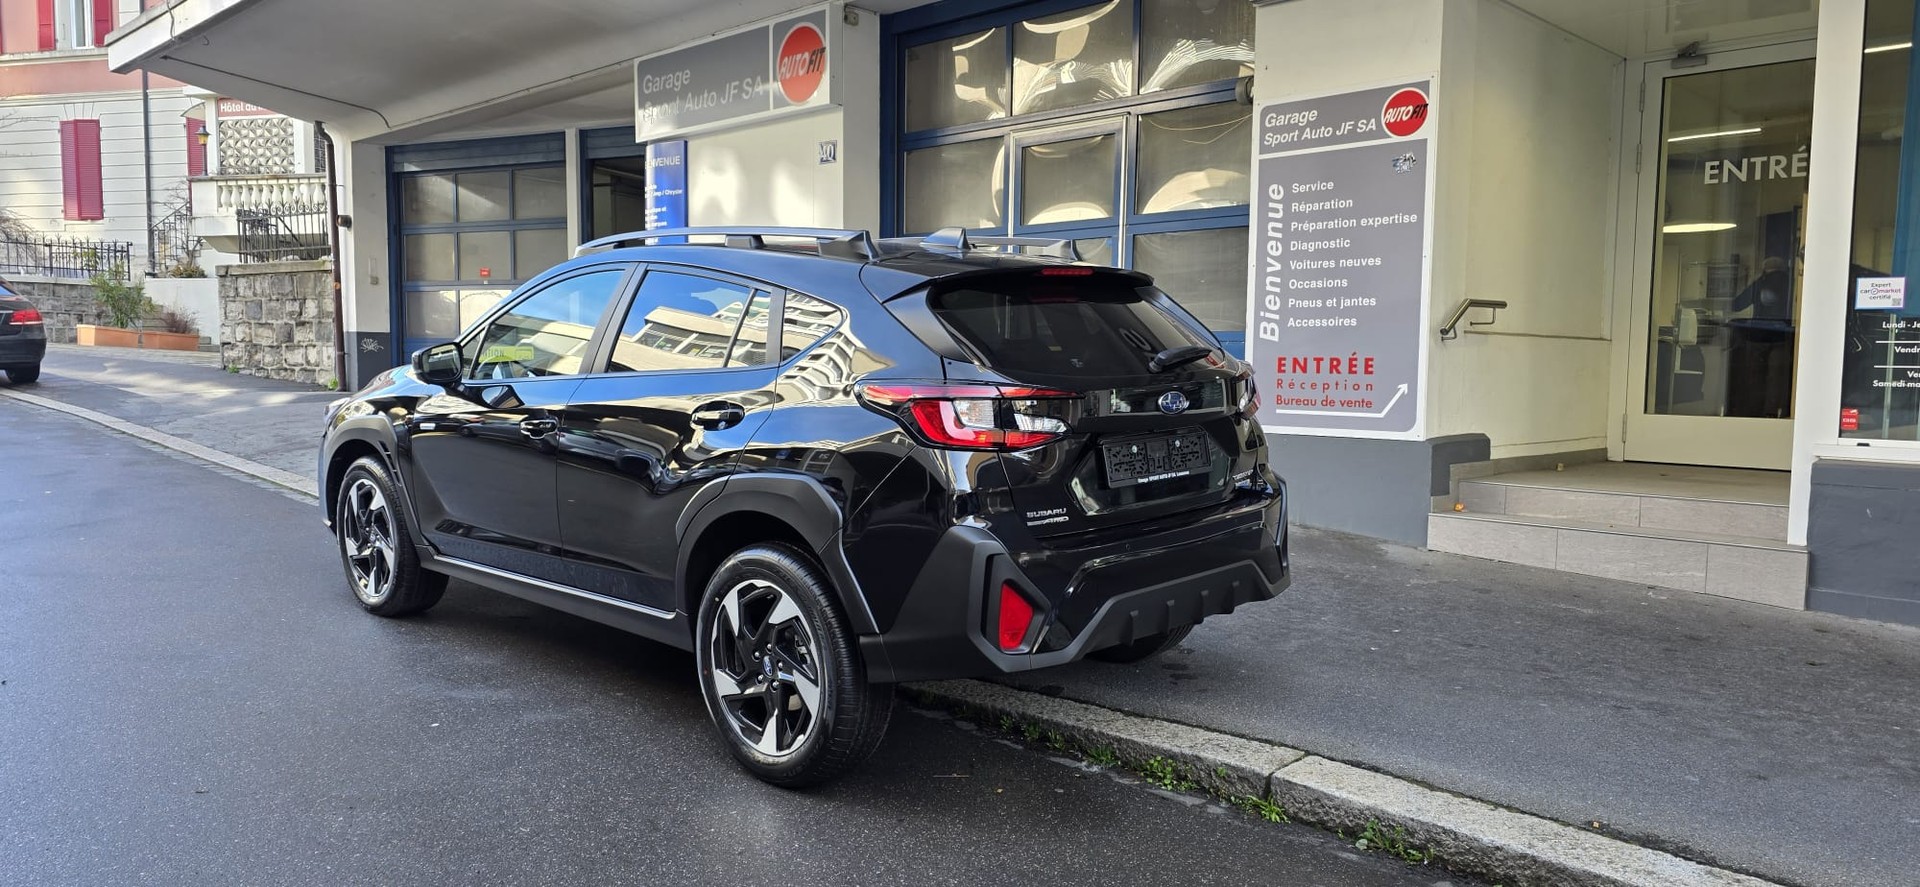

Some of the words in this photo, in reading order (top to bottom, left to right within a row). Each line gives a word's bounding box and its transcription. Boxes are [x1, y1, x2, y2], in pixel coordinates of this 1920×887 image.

[780, 47, 826, 80] AUTOFIT
[643, 69, 691, 95] Garage
[684, 92, 717, 113] Auto
[721, 81, 740, 104] JF
[742, 76, 765, 99] SA
[220, 102, 244, 112] Hôtel
[1384, 103, 1429, 123] AUTOFIT
[1265, 109, 1318, 128] Garage
[1264, 129, 1299, 147] Sport
[1301, 126, 1333, 141] Auto
[1336, 121, 1354, 136] JF
[1357, 118, 1377, 133] SA
[1292, 180, 1334, 193] Service
[1291, 198, 1353, 213] Réparation
[1291, 217, 1356, 233] Préparation
[1361, 213, 1418, 229] expertise
[1290, 237, 1351, 252] Diagnostic
[1259, 183, 1284, 342] Bienvenue
[1289, 258, 1336, 270] Voitures
[1339, 256, 1382, 268] neuves
[1289, 277, 1348, 290] Occasions
[1288, 298, 1322, 308] Pneus
[1326, 297, 1338, 307] et
[1340, 296, 1377, 309] jantes
[1287, 316, 1357, 328] Accessoires
[1276, 352, 1375, 375] ENTRÉE
[1276, 378, 1373, 393] Réception
[1276, 395, 1317, 407] Bureau
[1321, 395, 1336, 407] de
[1339, 397, 1373, 409] vente
[1026, 507, 1067, 518] SUBARU
